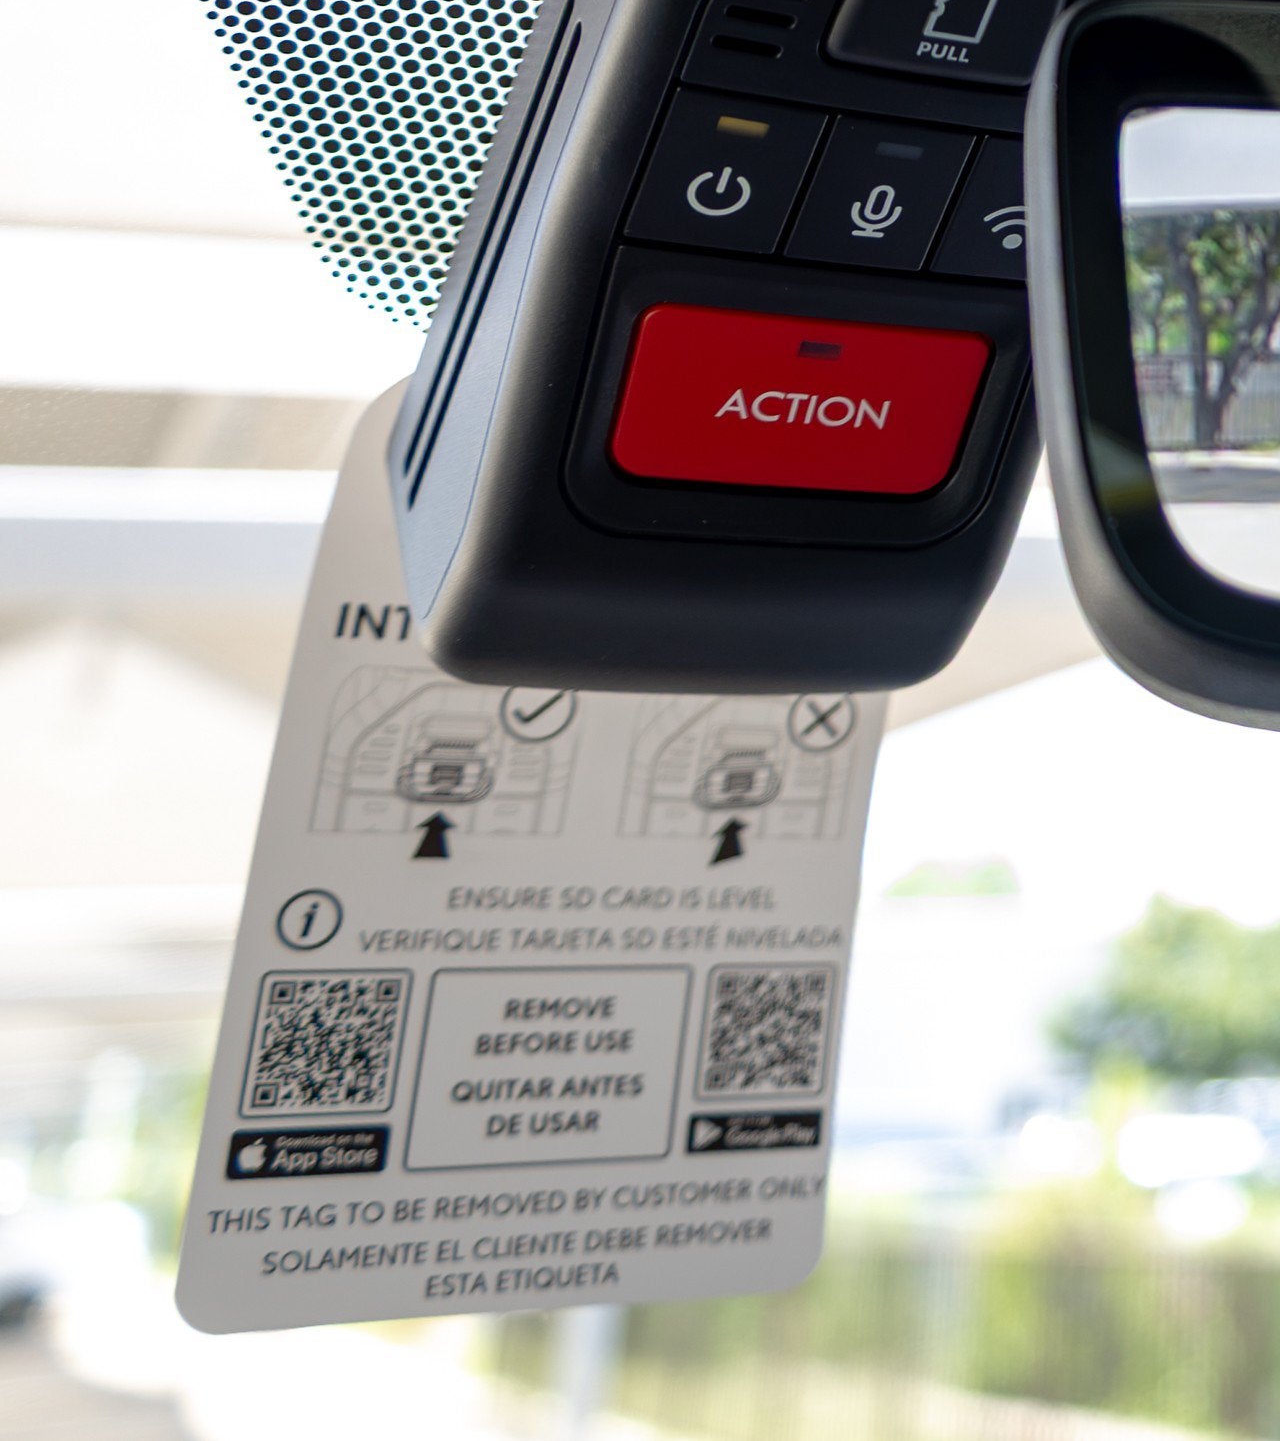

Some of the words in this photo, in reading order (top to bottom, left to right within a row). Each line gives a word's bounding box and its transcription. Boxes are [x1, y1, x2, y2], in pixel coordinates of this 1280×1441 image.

[916, 41, 969, 63] PULL
[714, 387, 891, 430] ACTION
[446, 885, 552, 911] ENSURE
[559, 886, 593, 910] SD
[600, 886, 674, 910] CARD
[678, 886, 701, 909] IS
[707, 886, 776, 910] LEVEL
[358, 929, 501, 953] VERIFIQUE
[509, 927, 613, 951] TARJETA
[620, 926, 655, 950] SD
[724, 925, 842, 949] NIVELADA
[502, 995, 617, 1021] REMOVE
[474, 1030, 578, 1056] BEFORE
[583, 1028, 635, 1052] USE
[450, 1077, 554, 1103] QUITAR
[559, 1072, 645, 1098] ANTES
[485, 1113, 523, 1137] DE
[528, 1109, 601, 1135] USAR
[270, 1148, 318, 1173] App
[320, 1145, 379, 1168] Store
[208, 1208, 270, 1233] THIS
[281, 1203, 337, 1229] TAG
[348, 1201, 384, 1225] TO
[393, 1197, 427, 1222] BE
[433, 1189, 566, 1218] REMOVED
[573, 1188, 607, 1209] BY
[612, 1178, 751, 1208] CUSTOMER
[758, 1174, 826, 1200] ONLY
[262, 1241, 428, 1275] SOLAMENTE
[436, 1240, 465, 1262] EL
[472, 1231, 578, 1259] CLIENTE
[584, 1226, 649, 1252] DEBE
[655, 1218, 773, 1246] REMOVER
[425, 1273, 488, 1298] ESTA
[495, 1262, 619, 1292] ETIQUETA
